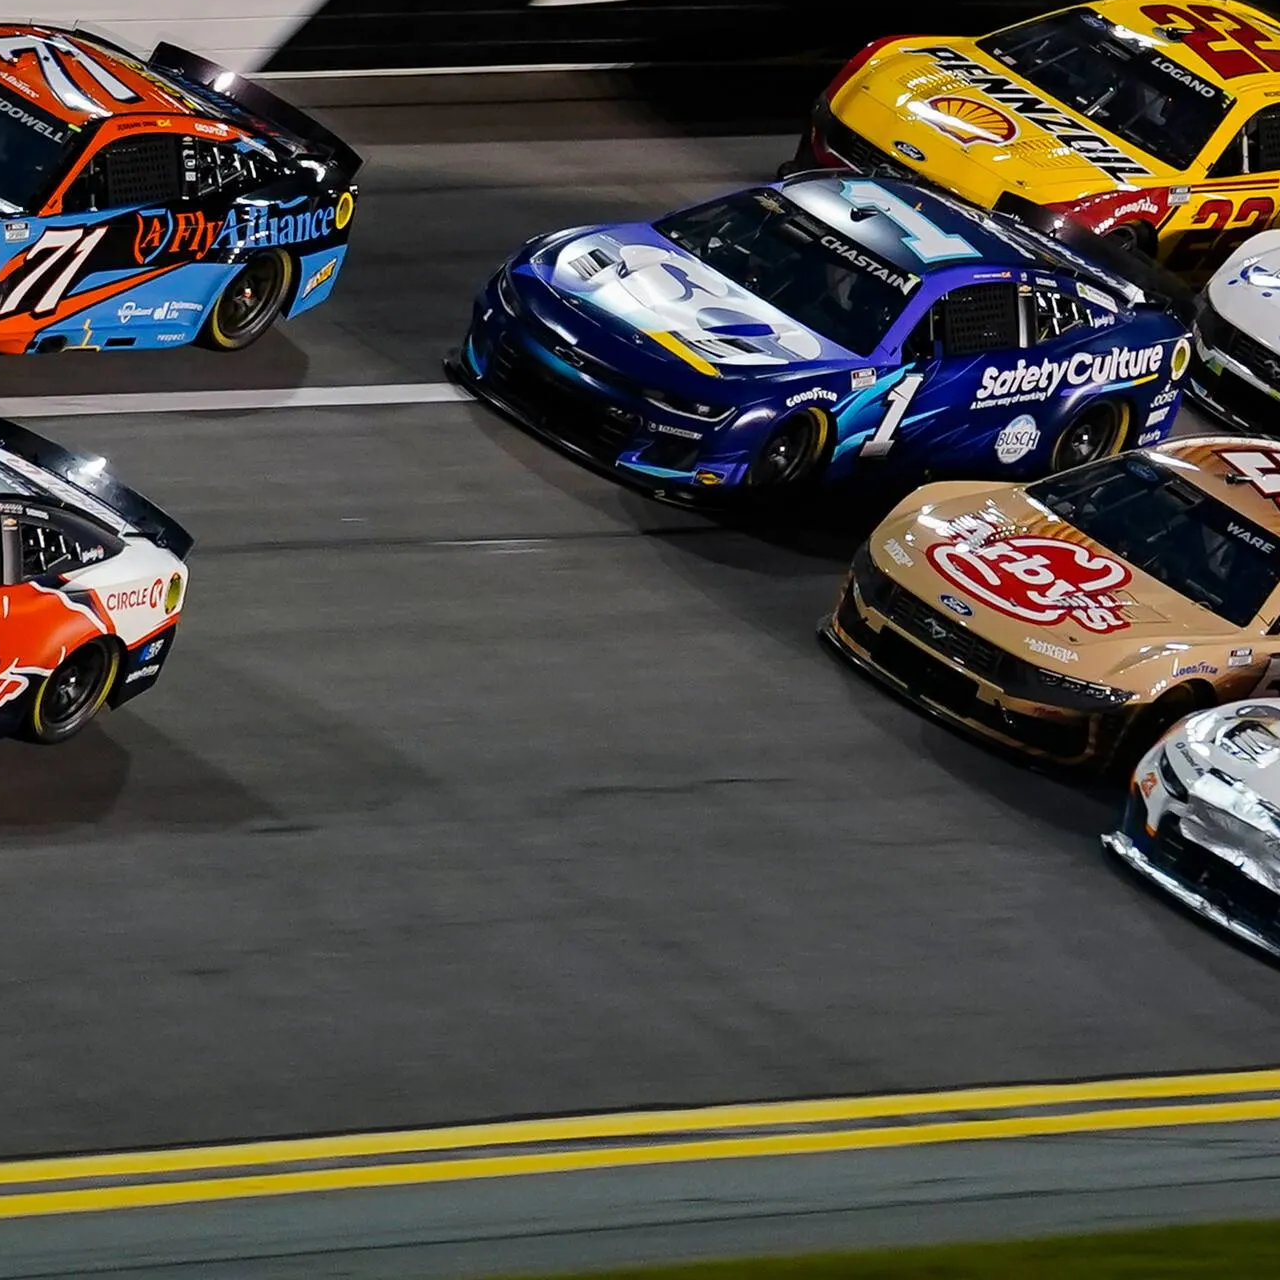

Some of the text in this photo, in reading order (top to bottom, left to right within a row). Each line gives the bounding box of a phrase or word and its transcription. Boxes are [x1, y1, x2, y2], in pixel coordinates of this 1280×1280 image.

[1150, 56, 1216, 98] LOGANO
[898, 45, 1154, 184] PENNZOIL
[841, 179, 983, 264] 1
[0, 225, 111, 315] 71
[820, 235, 910, 295] CHASTAIN
[785, 387, 838, 408] GOODYEAR
[976, 344, 1164, 399] SafetyCulture
[859, 373, 925, 458] 1
[996, 430, 1041, 449] BUSCH
[1226, 521, 1275, 555] WARE
[106, 588, 148, 611] CIRCLE
